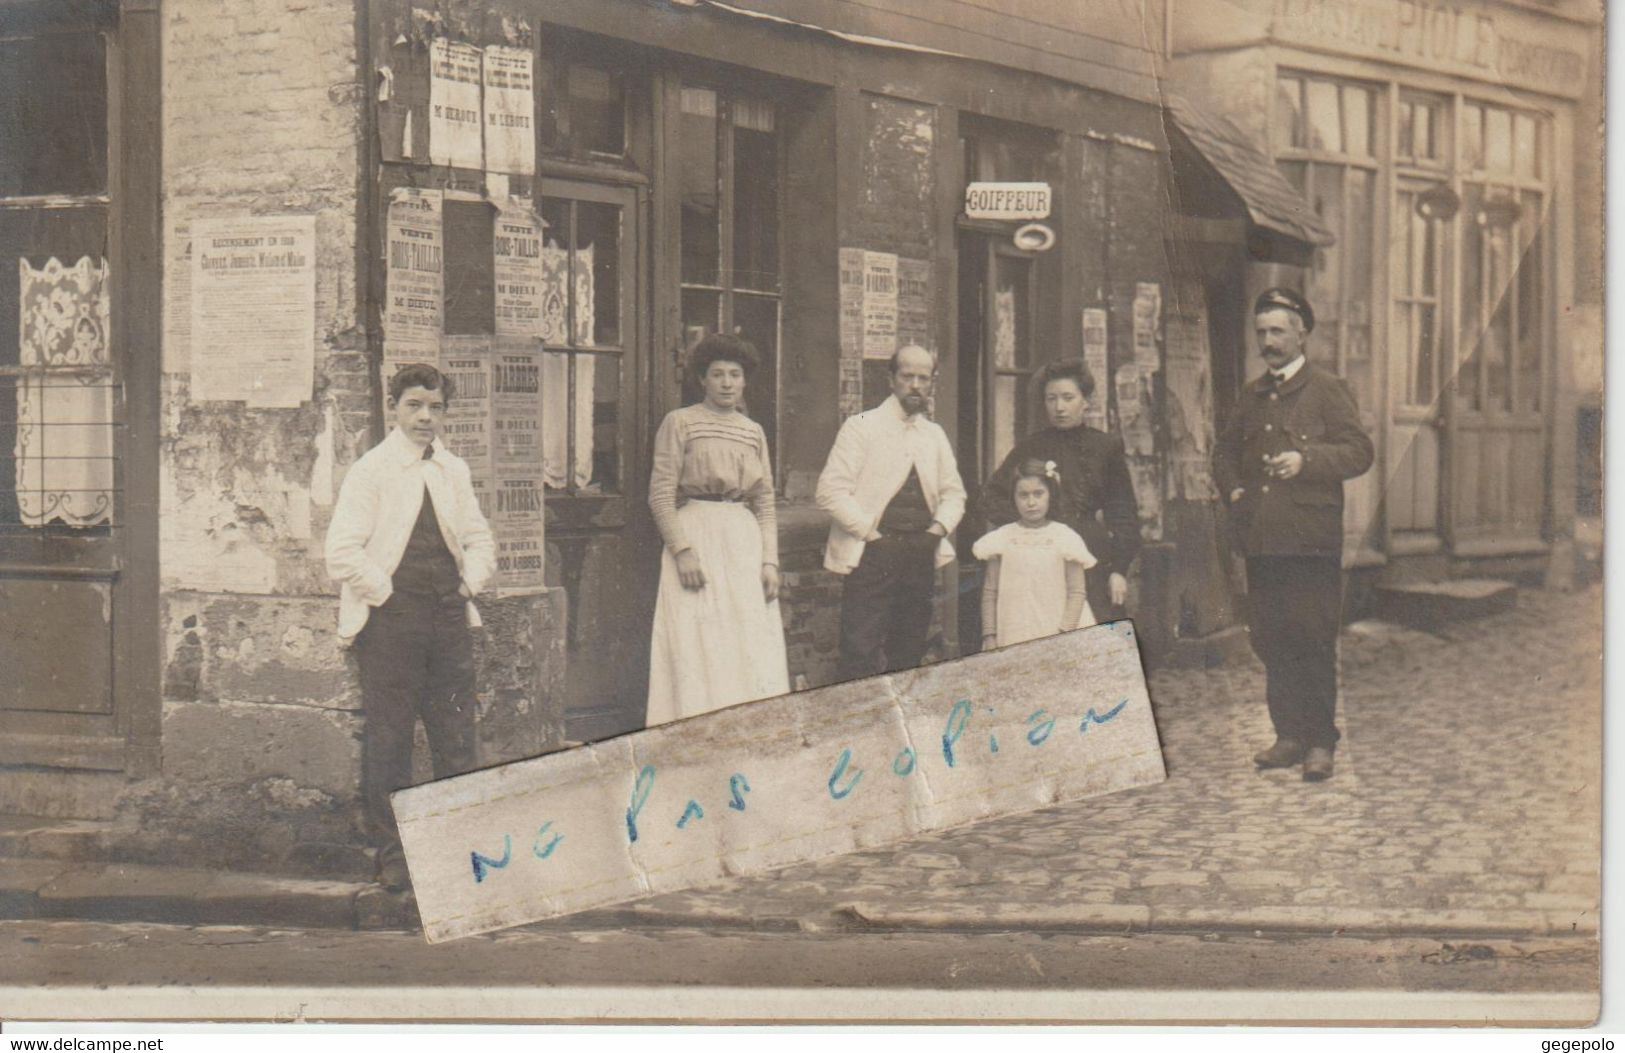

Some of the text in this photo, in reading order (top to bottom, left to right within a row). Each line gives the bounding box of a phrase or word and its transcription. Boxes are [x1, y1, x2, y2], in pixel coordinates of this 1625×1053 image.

[969, 190, 1047, 211] COIFFEUR
[400, 228, 433, 240] VENTE
[502, 225, 533, 235] VENTE
